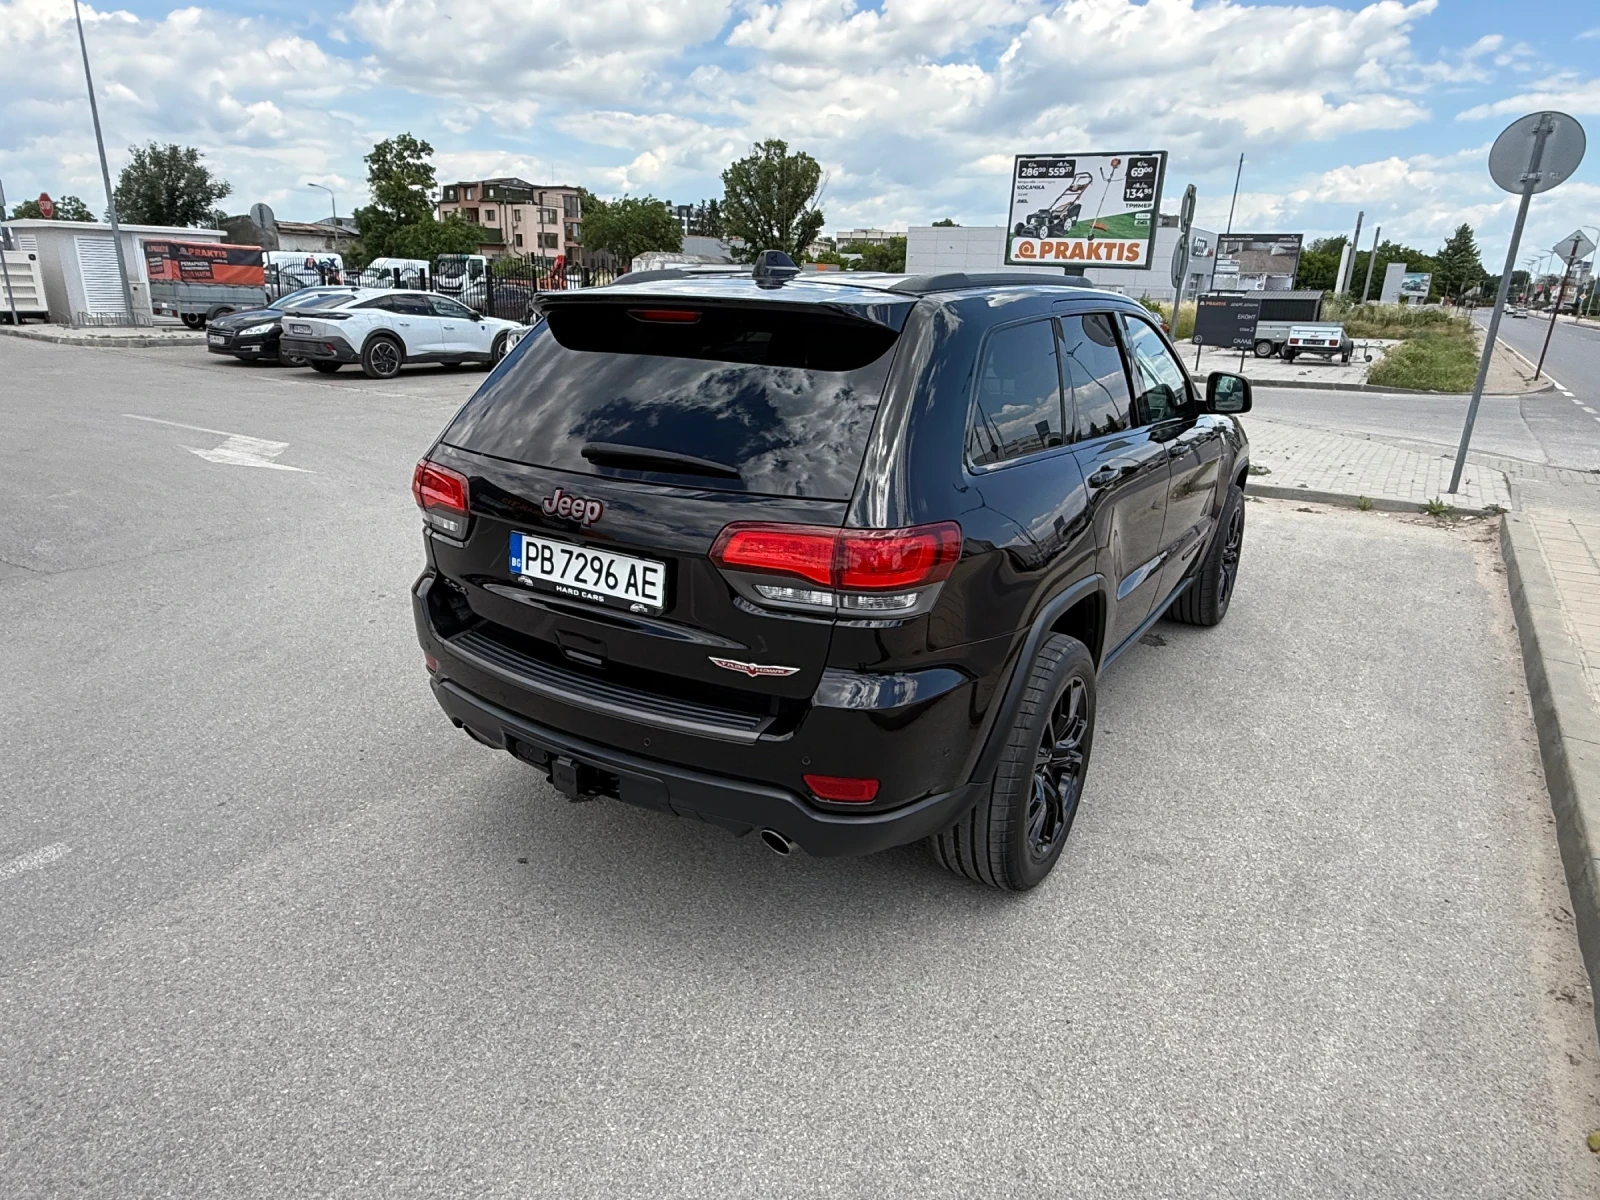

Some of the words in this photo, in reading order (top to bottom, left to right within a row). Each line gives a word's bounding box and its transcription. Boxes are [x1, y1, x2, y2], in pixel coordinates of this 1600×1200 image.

[40, 200, 51, 209] STOP
[187, 248, 228, 258] PRAKTIS
[1039, 241, 1141, 262] PRAKTIS
[542, 487, 603, 528] Jeep
[511, 557, 521, 567] BG
[556, 585, 580, 596] HARD
[581, 591, 604, 602] CARS
